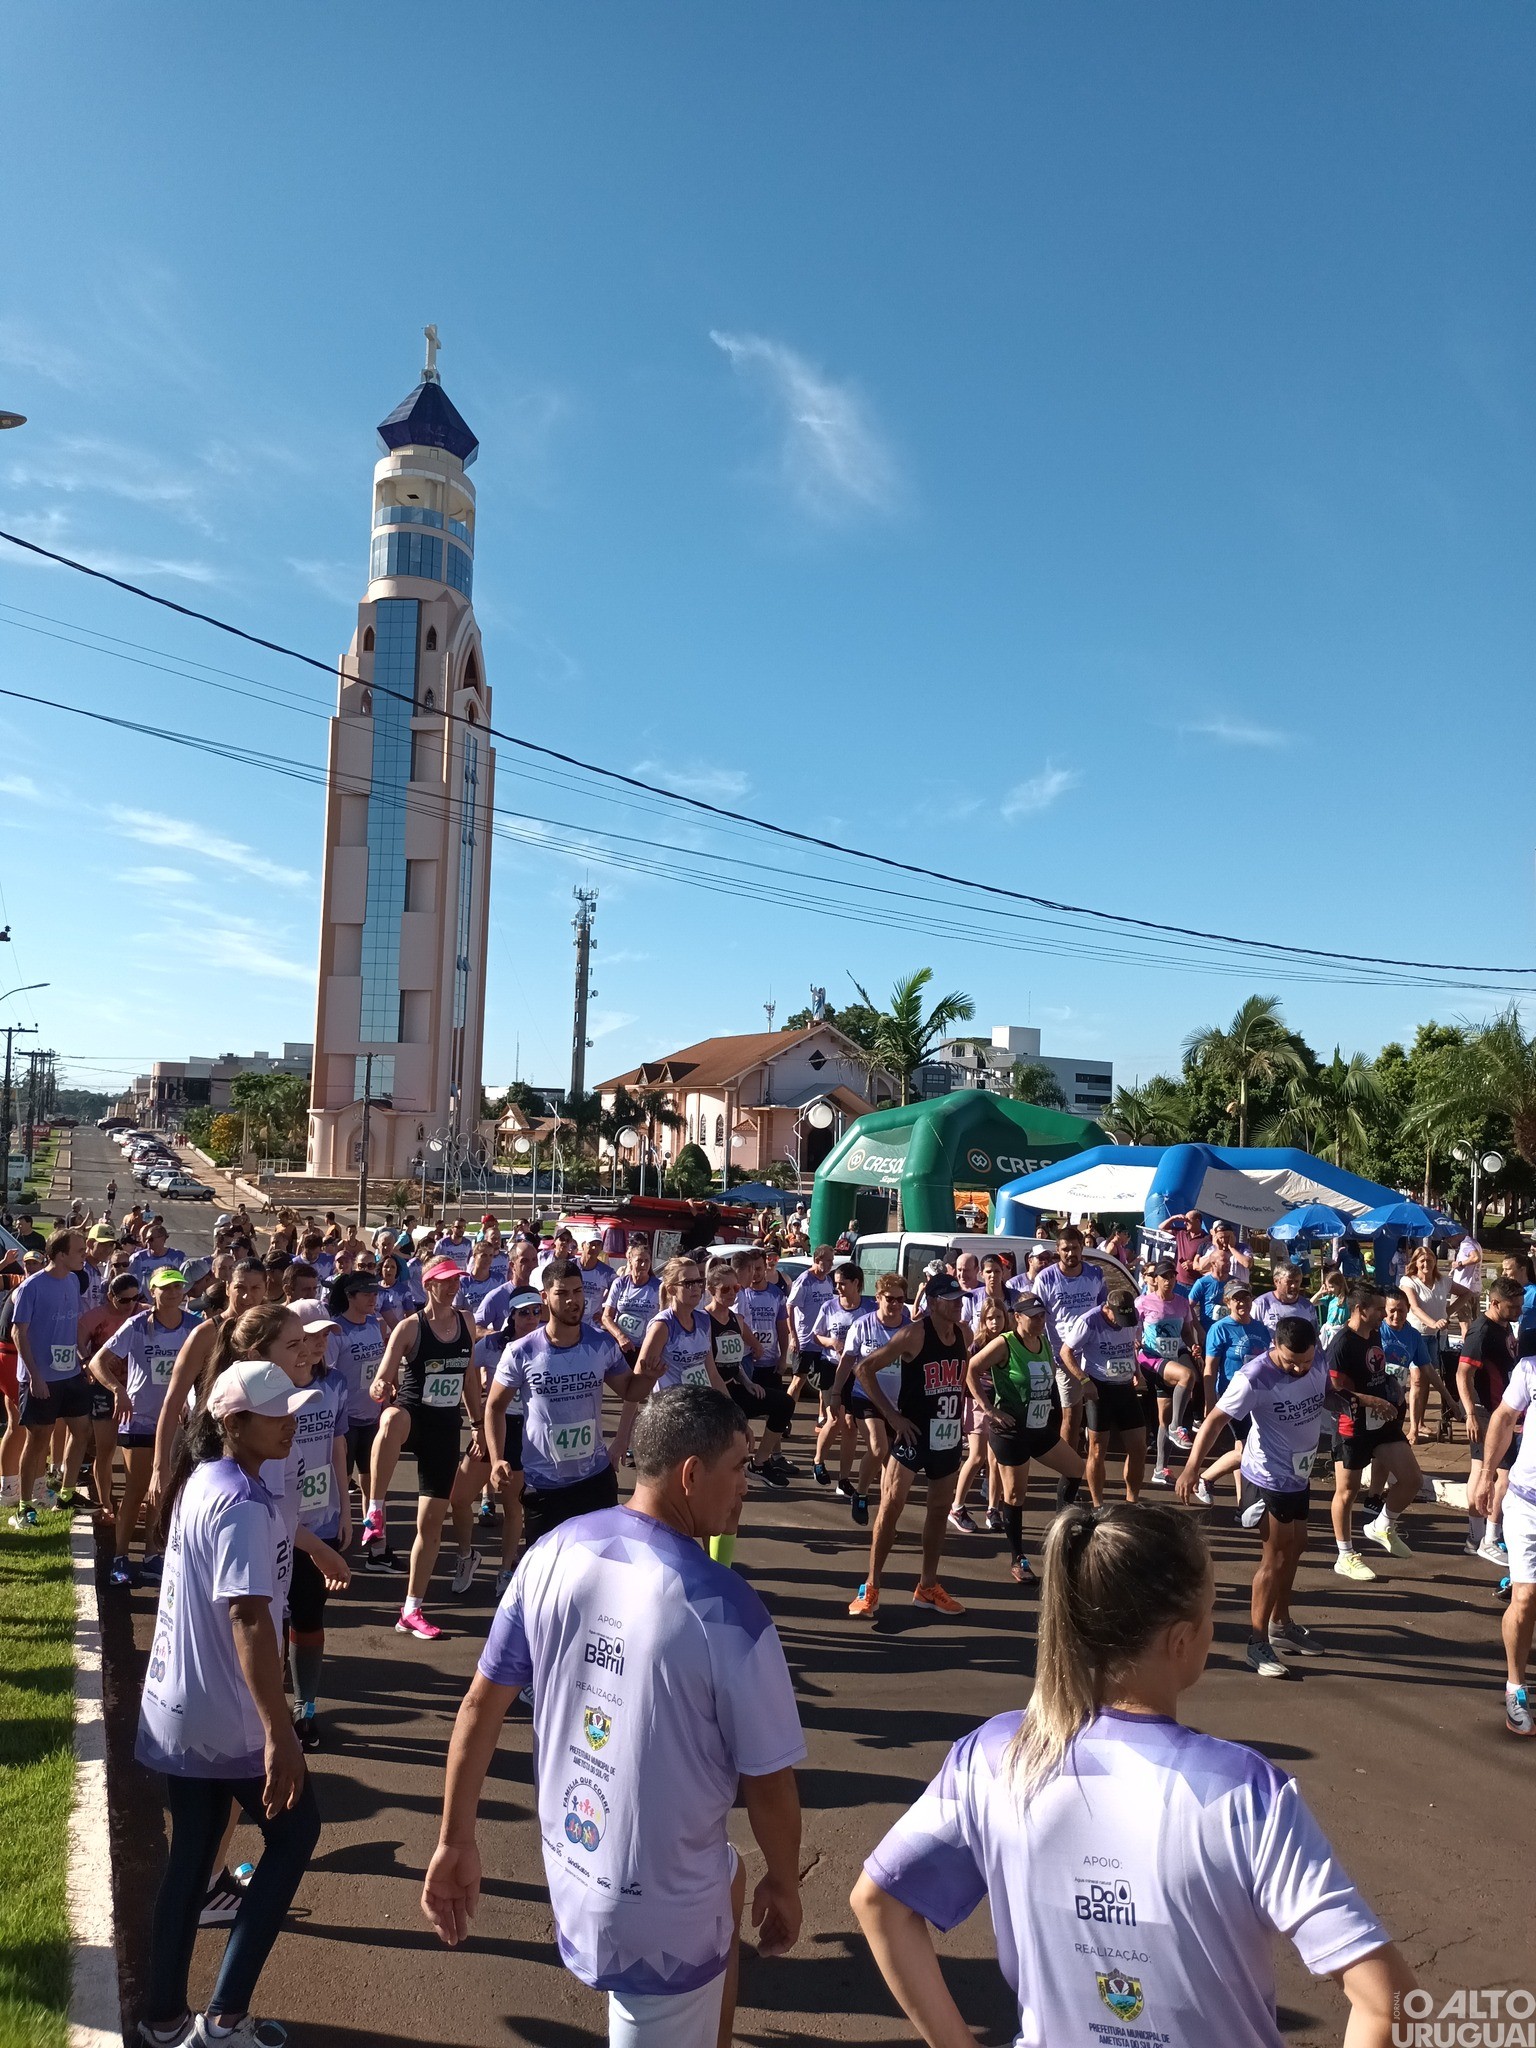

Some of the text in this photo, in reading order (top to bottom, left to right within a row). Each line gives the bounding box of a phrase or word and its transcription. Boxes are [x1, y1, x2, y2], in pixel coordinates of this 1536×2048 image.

[863, 1155, 906, 1174] CRESOL
[996, 1155, 1052, 1174] CRES
[621, 1316, 641, 1331] 637
[362, 1342, 384, 1353] RÚSTIC
[722, 1338, 742, 1355] 568
[1160, 1340, 1178, 1352] 519
[155, 1360, 175, 1376] 42
[1111, 1360, 1133, 1374] 553
[532, 1370, 597, 1386] 2ª RÚSTICA
[536, 1378, 603, 1395] DAS PEDRAS
[429, 1378, 460, 1397] 462
[550, 1395, 576, 1403] AMETISTA
[936, 1395, 958, 1419] 30
[1273, 1392, 1325, 1413] 2ª RÚSTICA
[1279, 1412, 1301, 1421] DAS
[556, 1425, 592, 1449] 476
[935, 1423, 959, 1440] 441
[598, 1637, 613, 1655] Do
[585, 1643, 625, 1676] Barril
[610, 1766, 616, 1776] DE
[579, 1776, 593, 1786] QUE
[1083, 1855, 1123, 1870] APOIO:
[620, 1886, 643, 1896] Senac
[1091, 1884, 1115, 1905] Do
[1075, 1894, 1137, 1927] Barril
[1074, 1942, 1152, 1964] REALIZAÇÃO:
[1088, 2022, 1171, 2043] PREFEITURA MUNICIPAL DE
[1098, 2035, 1130, 2048] AMETISTA
